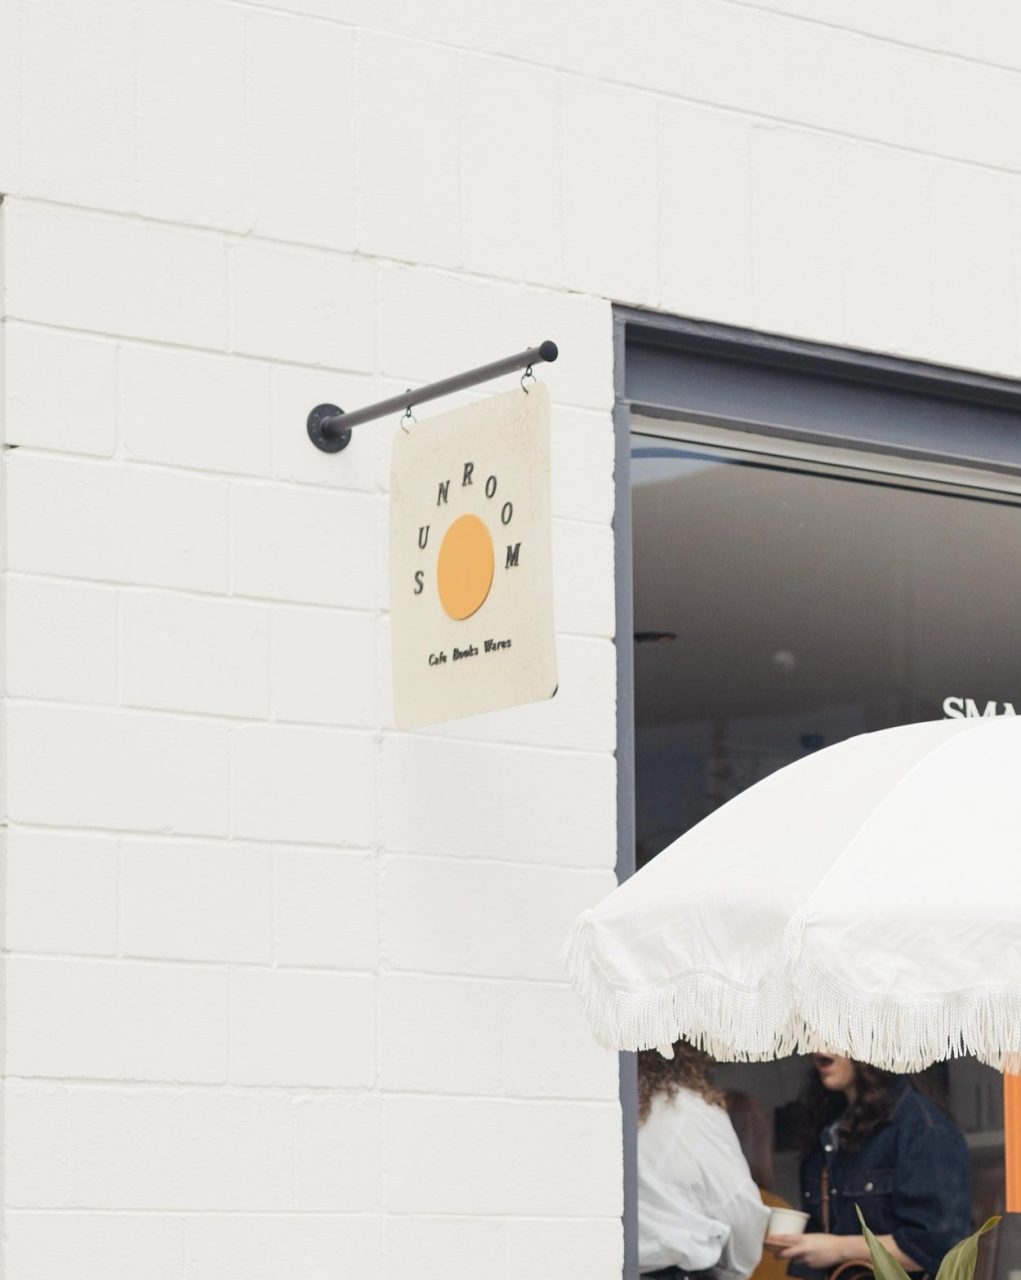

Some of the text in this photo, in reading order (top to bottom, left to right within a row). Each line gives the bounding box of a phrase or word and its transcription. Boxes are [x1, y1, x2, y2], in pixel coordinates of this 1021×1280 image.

[413, 462, 521, 595] SUNROOM
[428, 639, 511, 666] Cafe Books Wares
